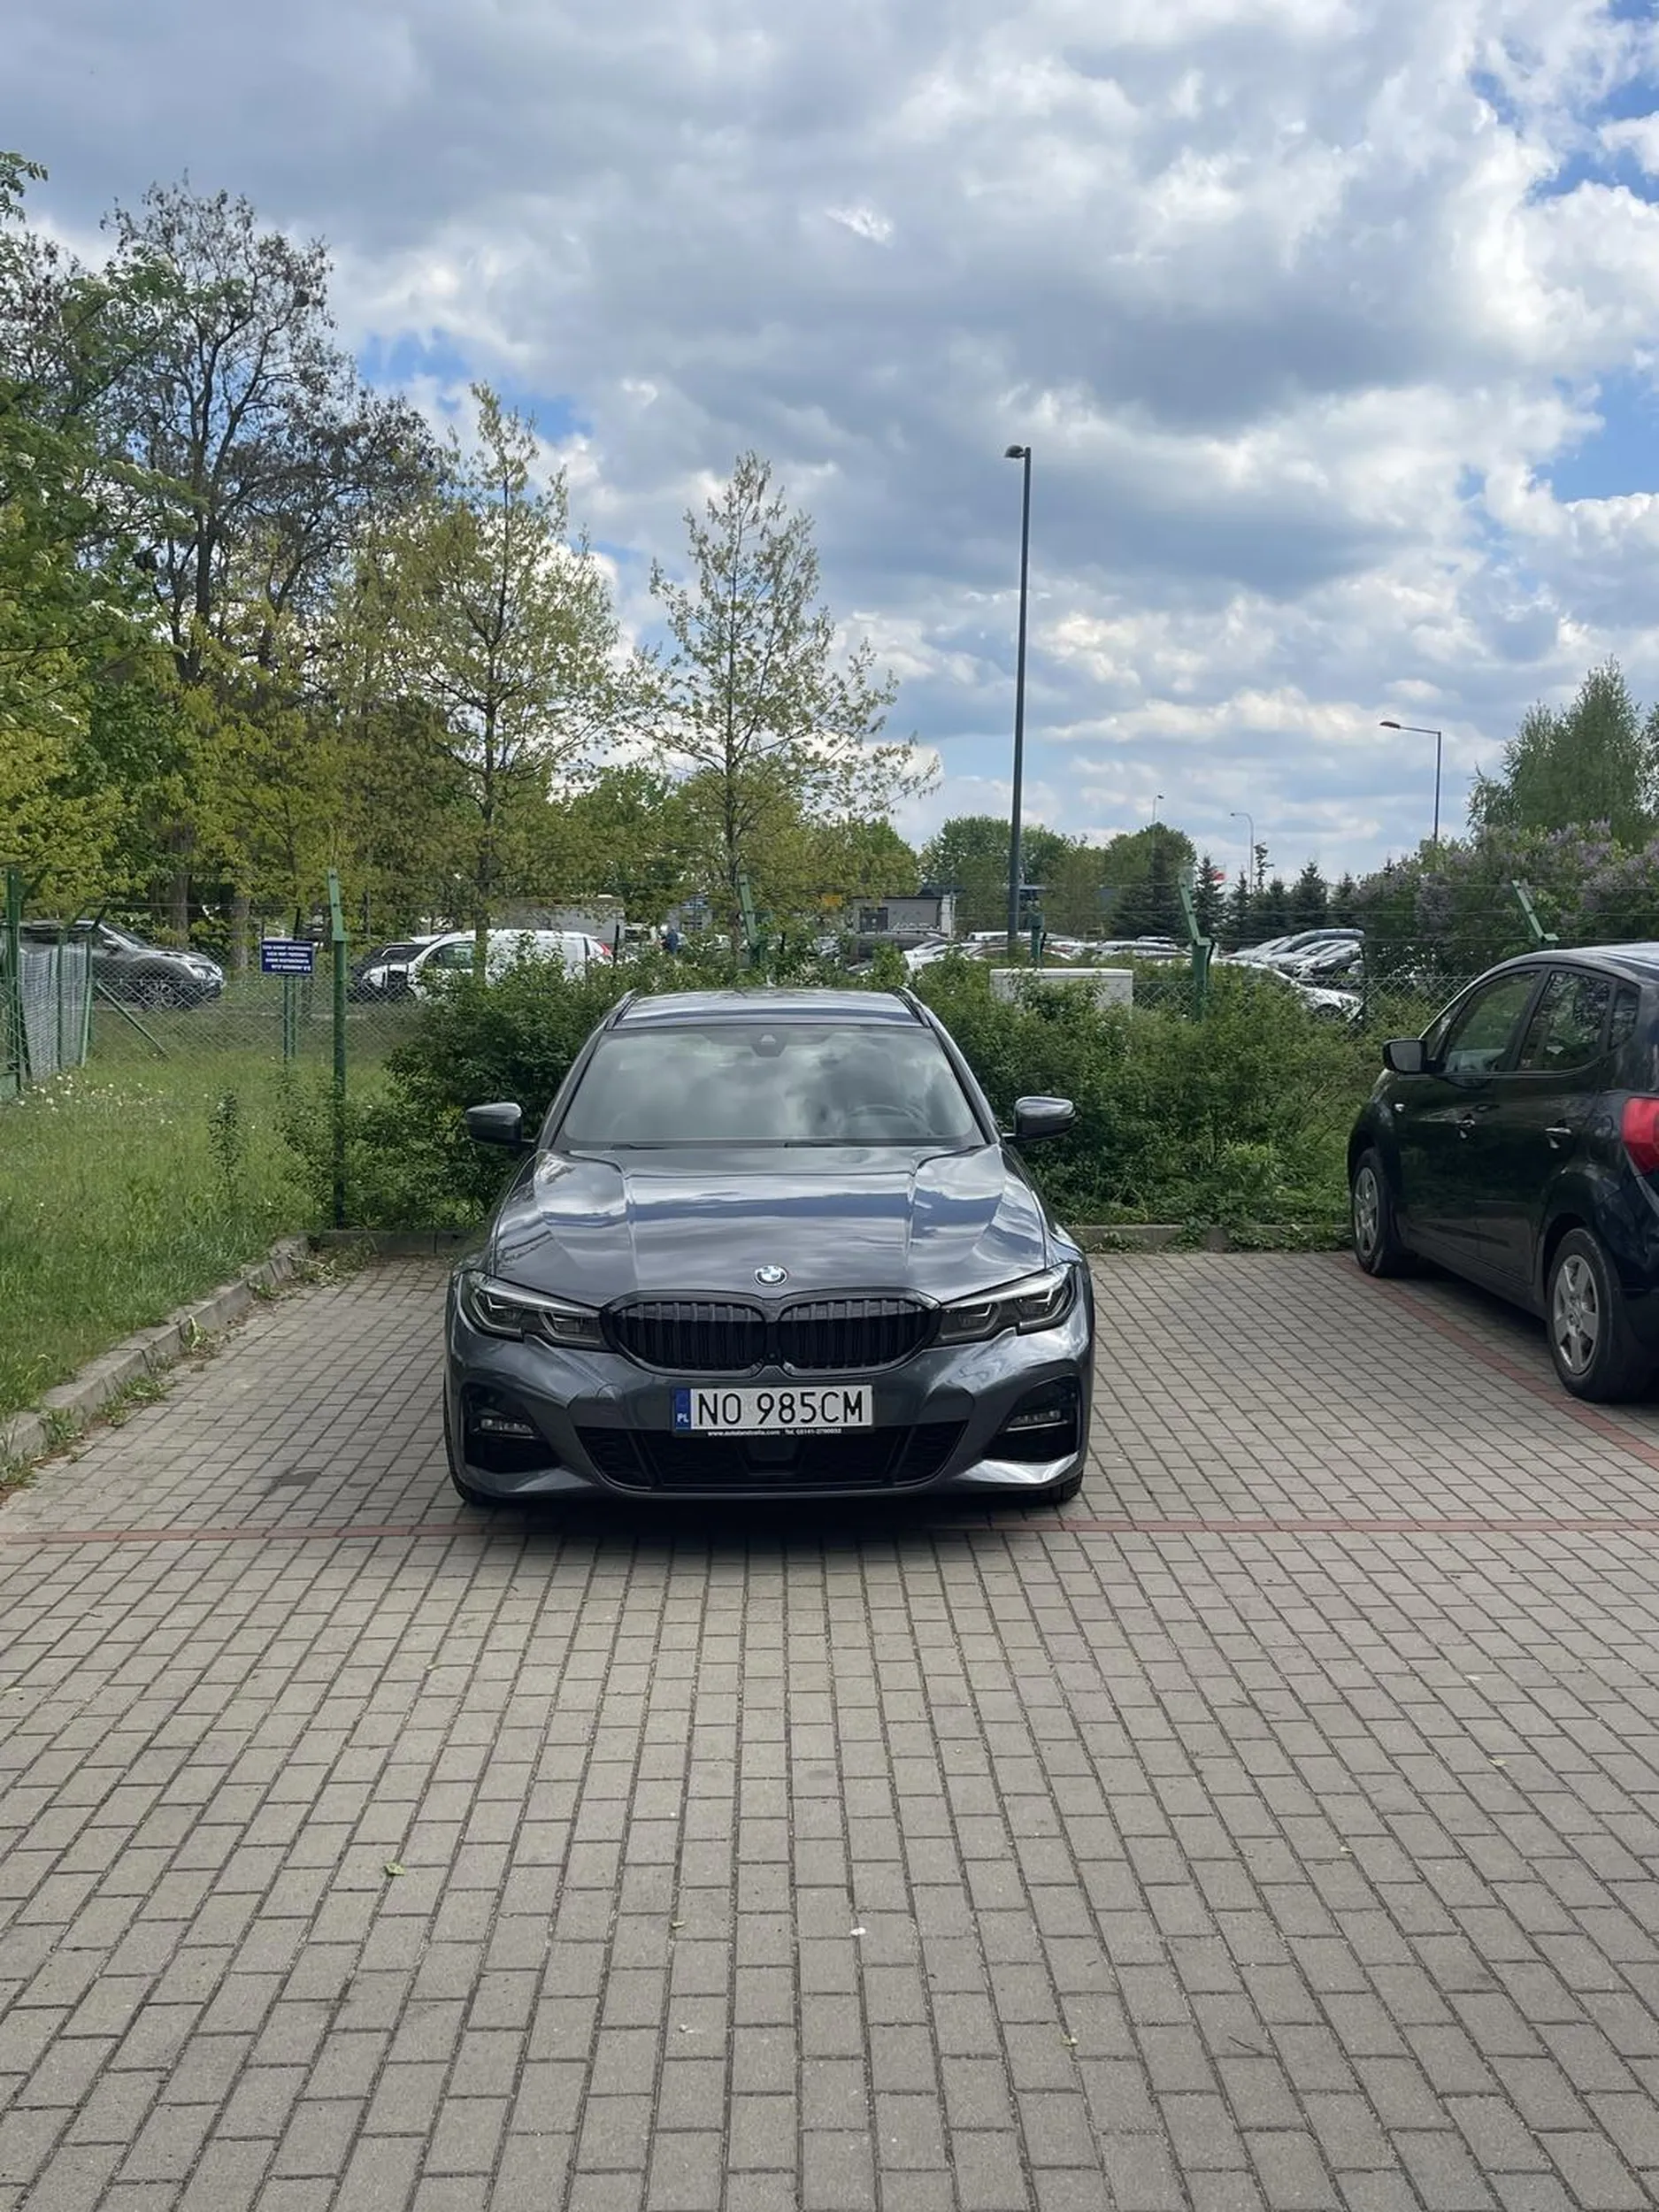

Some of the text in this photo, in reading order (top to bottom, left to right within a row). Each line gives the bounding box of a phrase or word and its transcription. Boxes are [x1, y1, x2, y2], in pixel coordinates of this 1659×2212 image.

[677, 1413, 689, 1424] PL
[698, 1390, 863, 1425] NO 985CM
